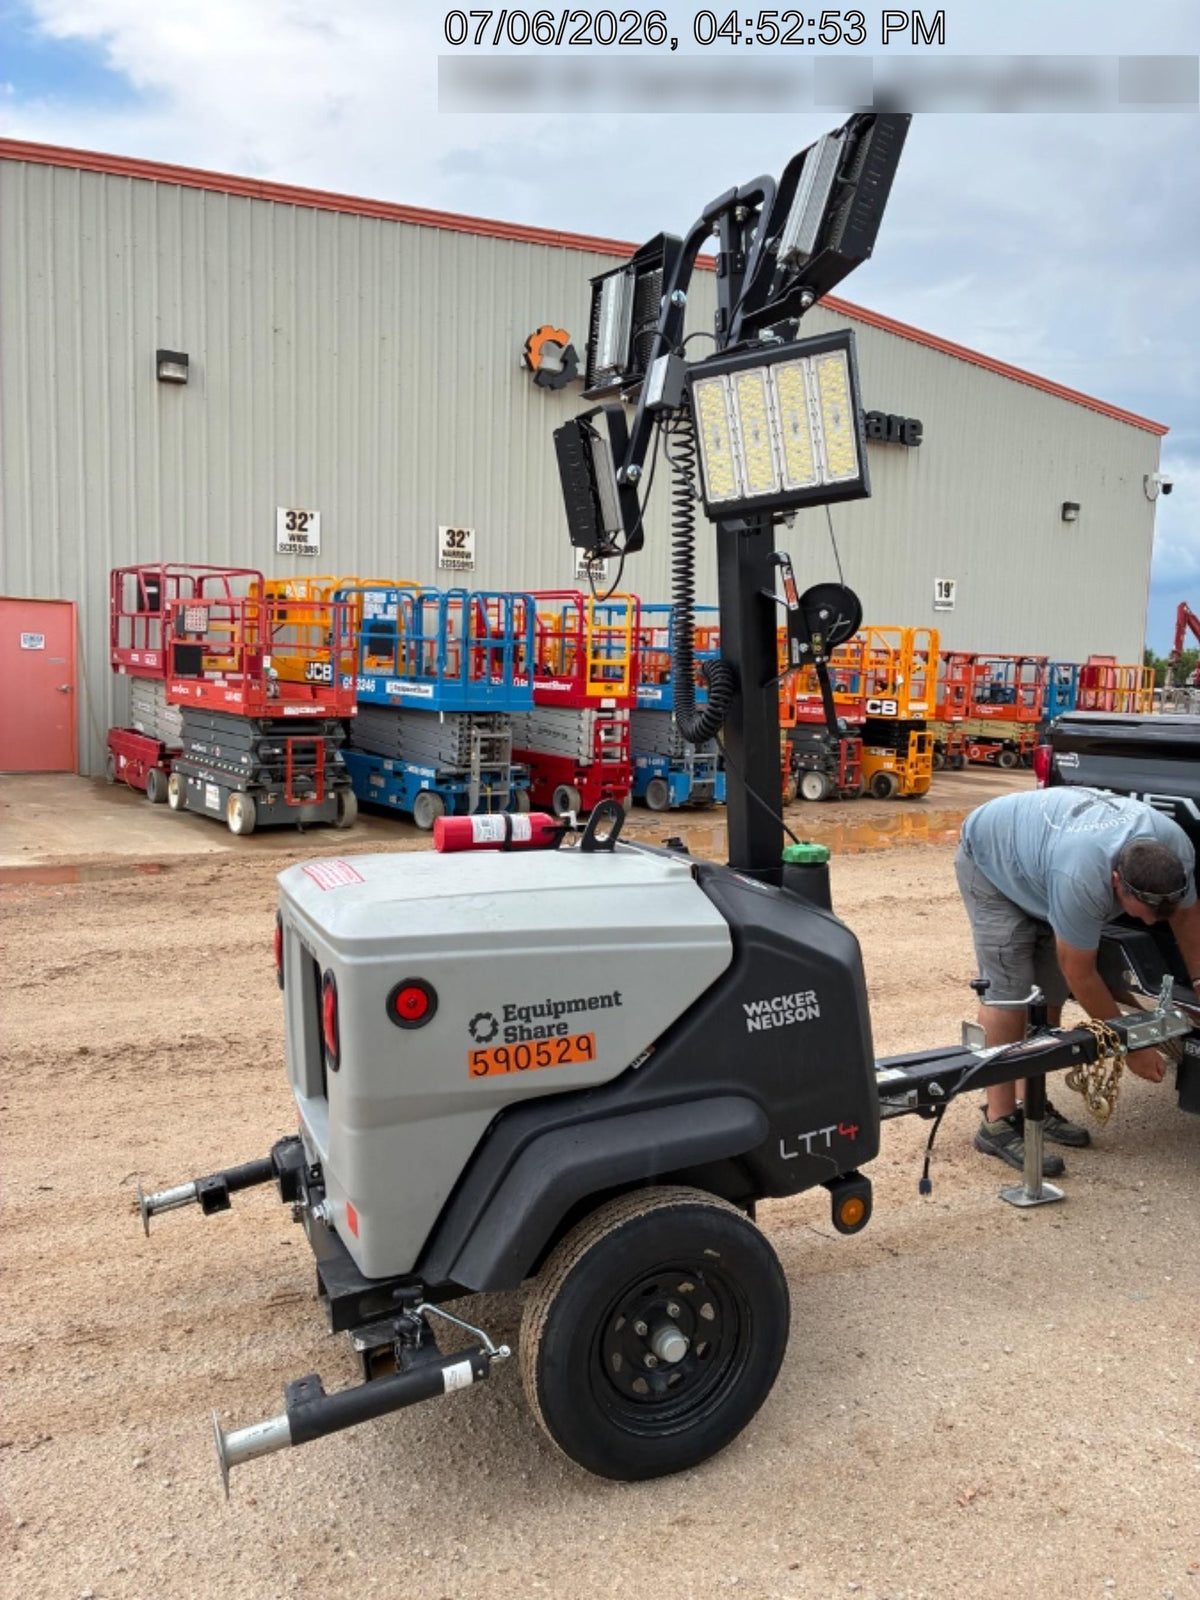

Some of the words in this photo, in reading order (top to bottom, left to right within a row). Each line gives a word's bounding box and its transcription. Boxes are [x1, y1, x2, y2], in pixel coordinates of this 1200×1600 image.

[286, 511, 314, 532] 32'
[446, 529, 470, 548] 32'
[305, 662, 333, 680] JCB
[866, 699, 897, 716] CB
[502, 990, 622, 1023] Equipment
[742, 990, 819, 1017] WACKER
[746, 1004, 821, 1033] NEUSON
[503, 1022, 568, 1044] Share
[473, 1035, 593, 1077] 590529
[780, 1122, 858, 1160] LTT4
